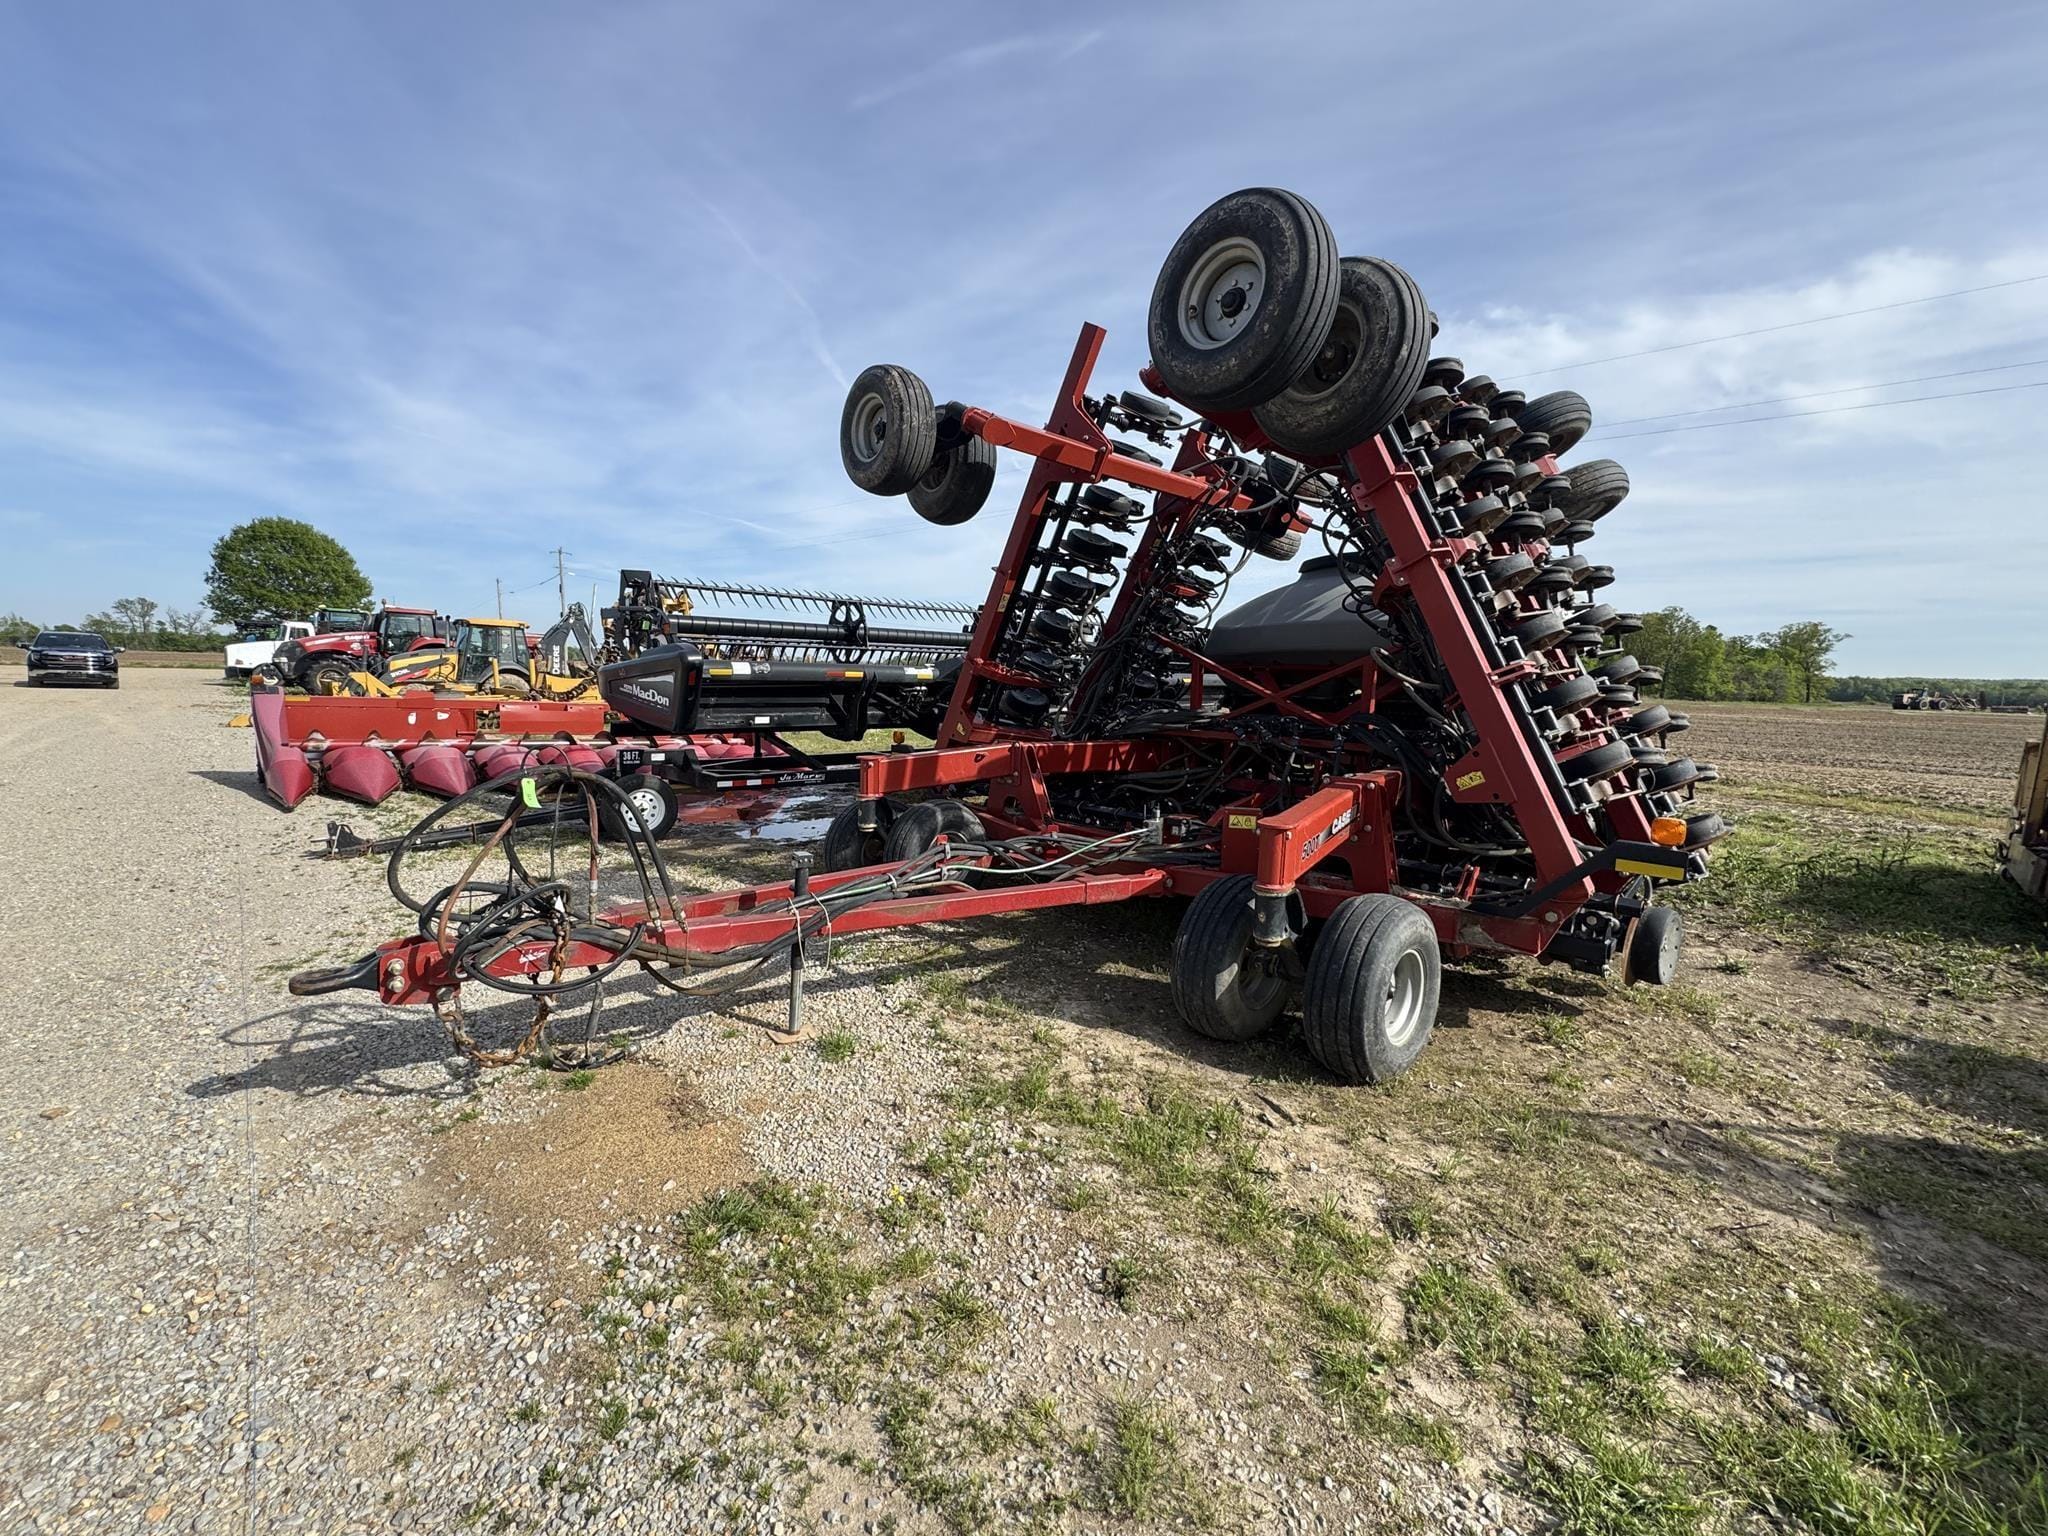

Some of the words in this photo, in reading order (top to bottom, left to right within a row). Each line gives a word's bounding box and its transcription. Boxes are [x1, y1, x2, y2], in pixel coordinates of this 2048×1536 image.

[552, 644, 560, 675] DEERE
[632, 683, 670, 706] MacDon
[1331, 808, 1352, 835] CASE
